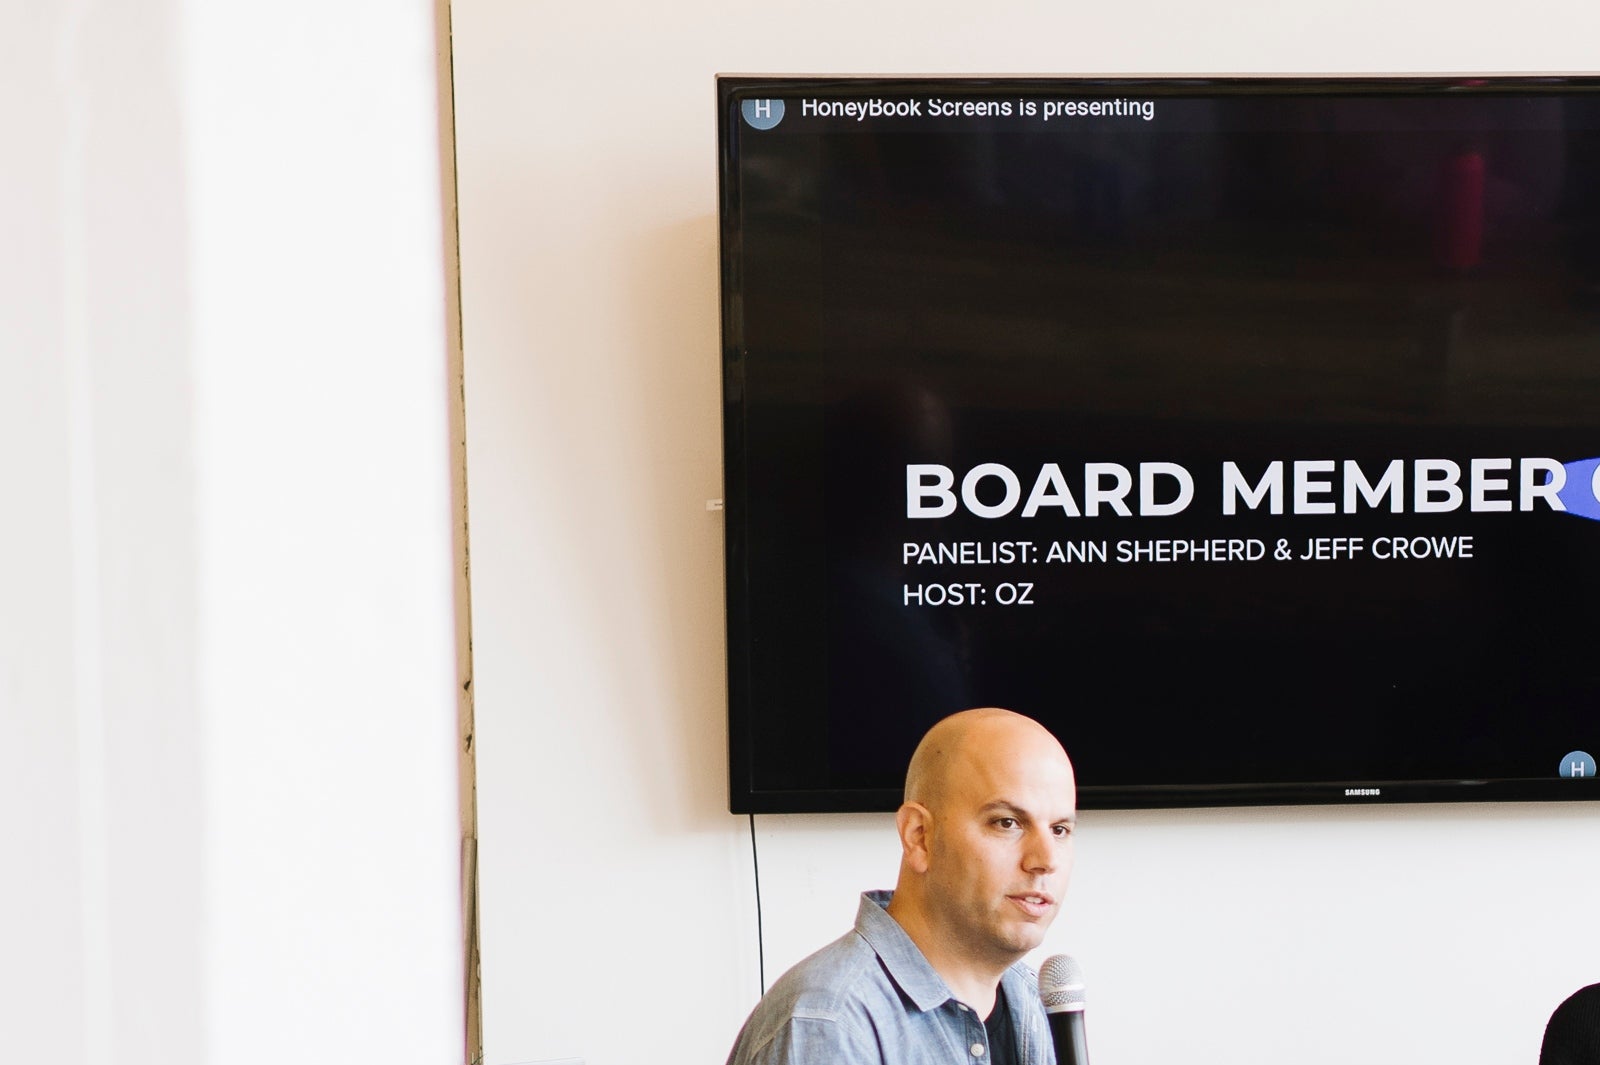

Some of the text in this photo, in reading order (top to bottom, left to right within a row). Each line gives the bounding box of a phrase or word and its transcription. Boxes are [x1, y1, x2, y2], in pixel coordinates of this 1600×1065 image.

[802, 98, 1155, 122] HoneyBook Screens is presenting
[906, 462, 1195, 519] BOARD
[1222, 457, 1567, 516] MEMBER
[903, 536, 1474, 565] PANELIST: ANN SHEPHERD & JEFF CROWE
[903, 582, 1034, 606] HOST: OZ
[1571, 761, 1585, 777] H
[1344, 788, 1381, 796] SAMSUNG
